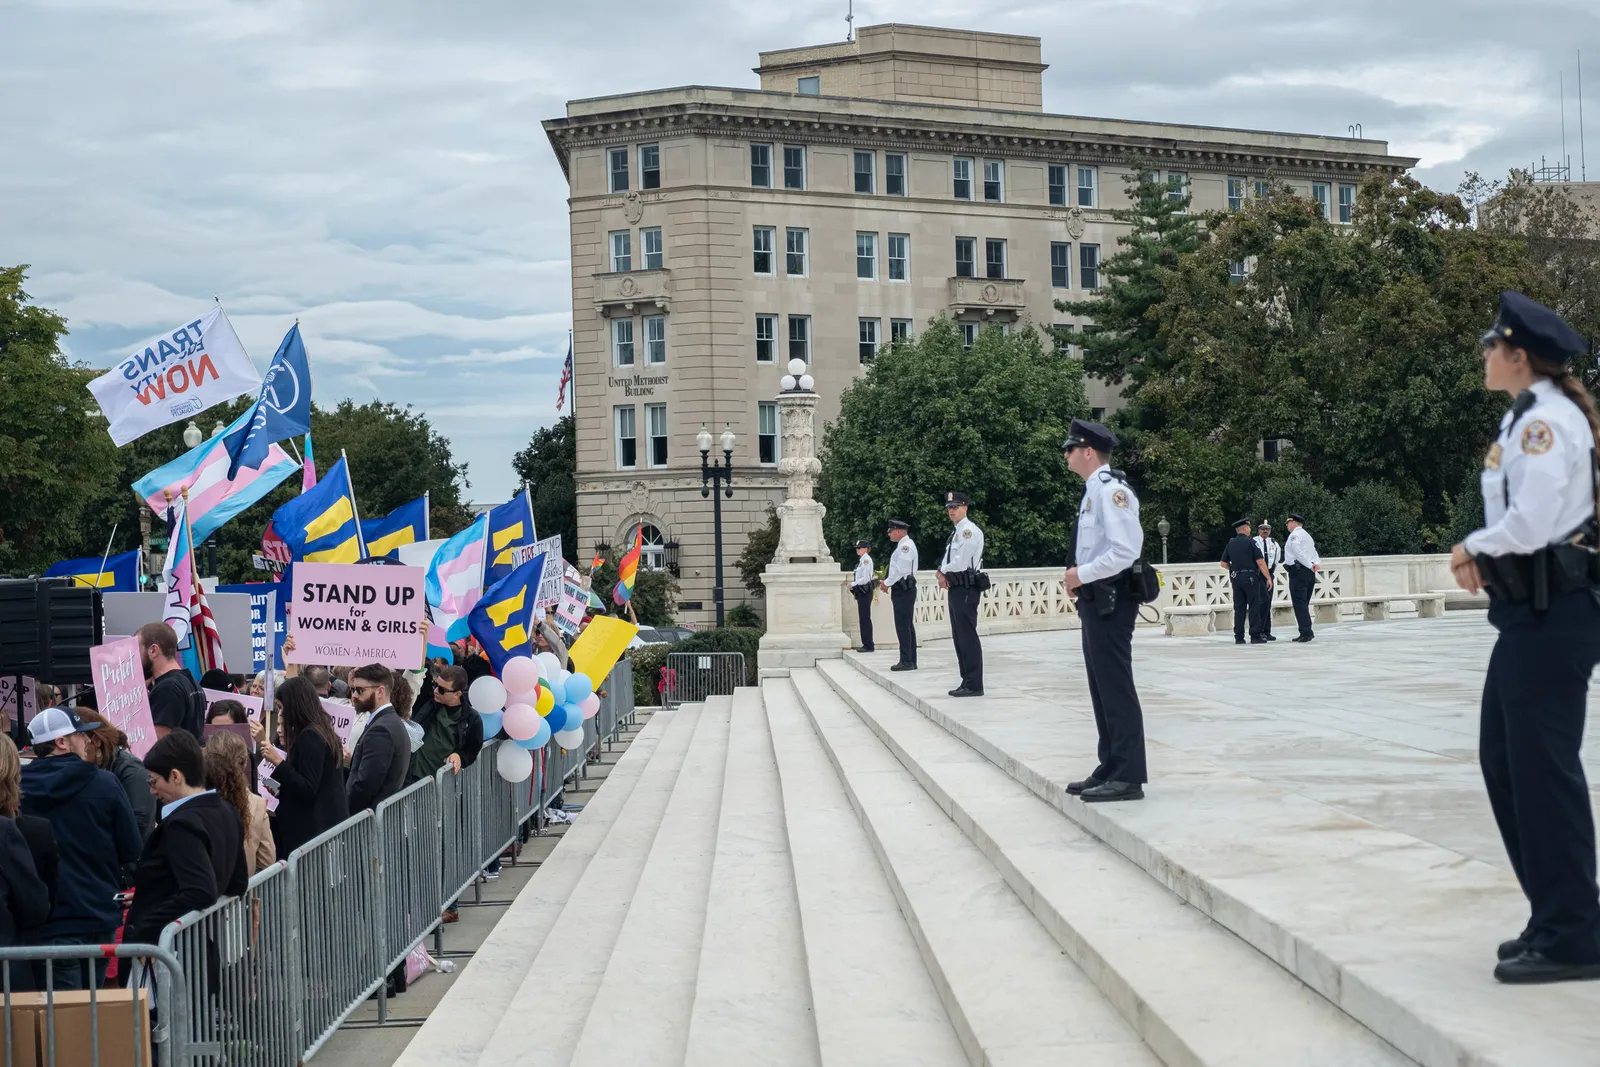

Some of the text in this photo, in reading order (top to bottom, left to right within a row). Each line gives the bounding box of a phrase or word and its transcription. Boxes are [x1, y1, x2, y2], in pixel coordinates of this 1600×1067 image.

[633, 375, 669, 386] METHODIST
[625, 386, 654, 397] BUILDING
[303, 582, 416, 606] STAND UP
[349, 606, 367, 618] for
[298, 617, 417, 634] WOMEN & GIRLS
[337, 717, 350, 729] UP
